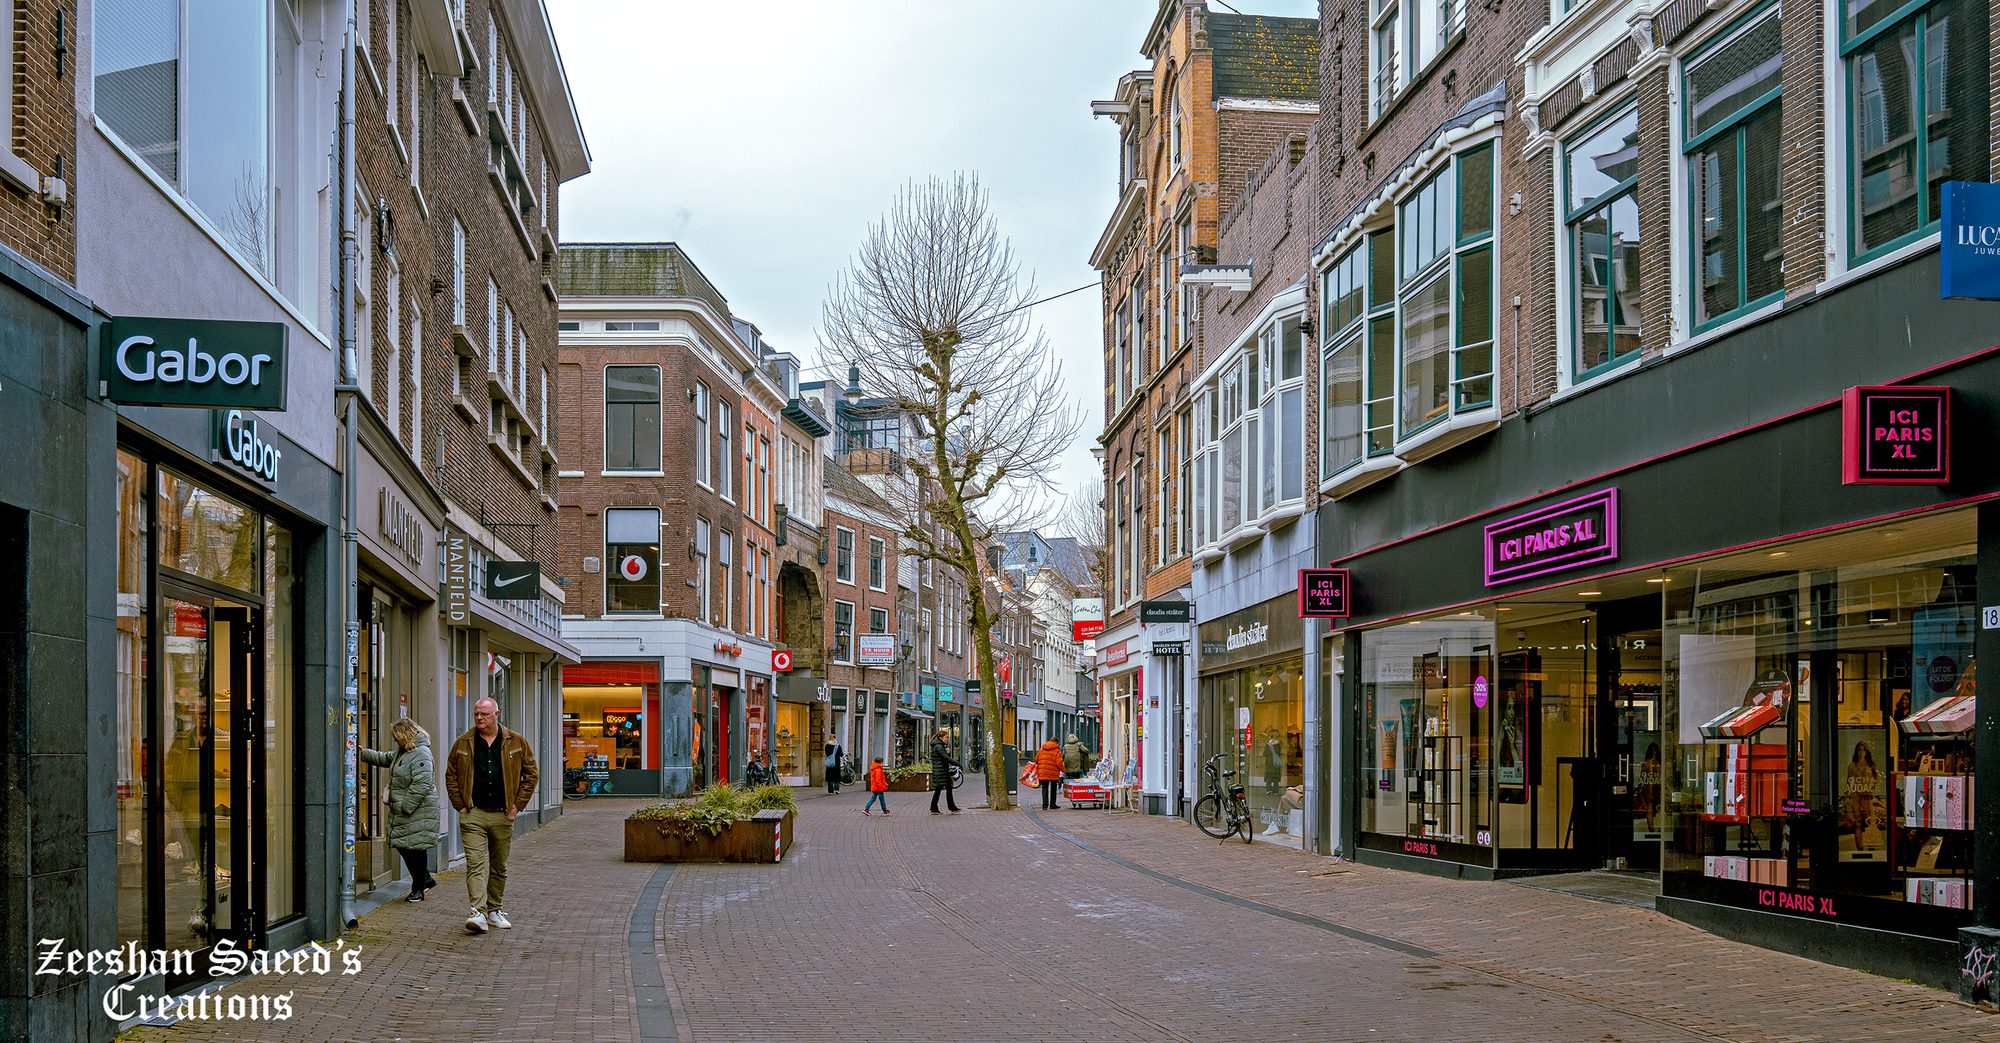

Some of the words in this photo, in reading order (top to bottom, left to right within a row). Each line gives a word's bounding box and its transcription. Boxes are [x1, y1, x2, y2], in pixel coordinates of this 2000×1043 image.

[116, 335, 271, 386] Gabor
[1890, 410, 1918, 424] ICI
[227, 409, 281, 482] Gabor
[1875, 427, 1933, 442] PARIS
[1891, 444, 1917, 458] XL
[380, 487, 425, 566] MANFIELD
[1500, 538, 1522, 562] ICI
[1524, 525, 1570, 555] PARIS
[1573, 519, 1596, 543] XL
[450, 537, 465, 622] MANFIELD
[1311, 589, 1340, 597] PARIS
[1984, 609, 1998, 627] 18
[1226, 625, 1246, 651] claudia
[1404, 841, 1412, 852] ICI
[1413, 842, 1429, 854] PARIS
[1430, 843, 1437, 855] XL
[1759, 889, 1775, 906] ICI
[1779, 892, 1815, 912] PARIS
[1820, 897, 1836, 915] XL
